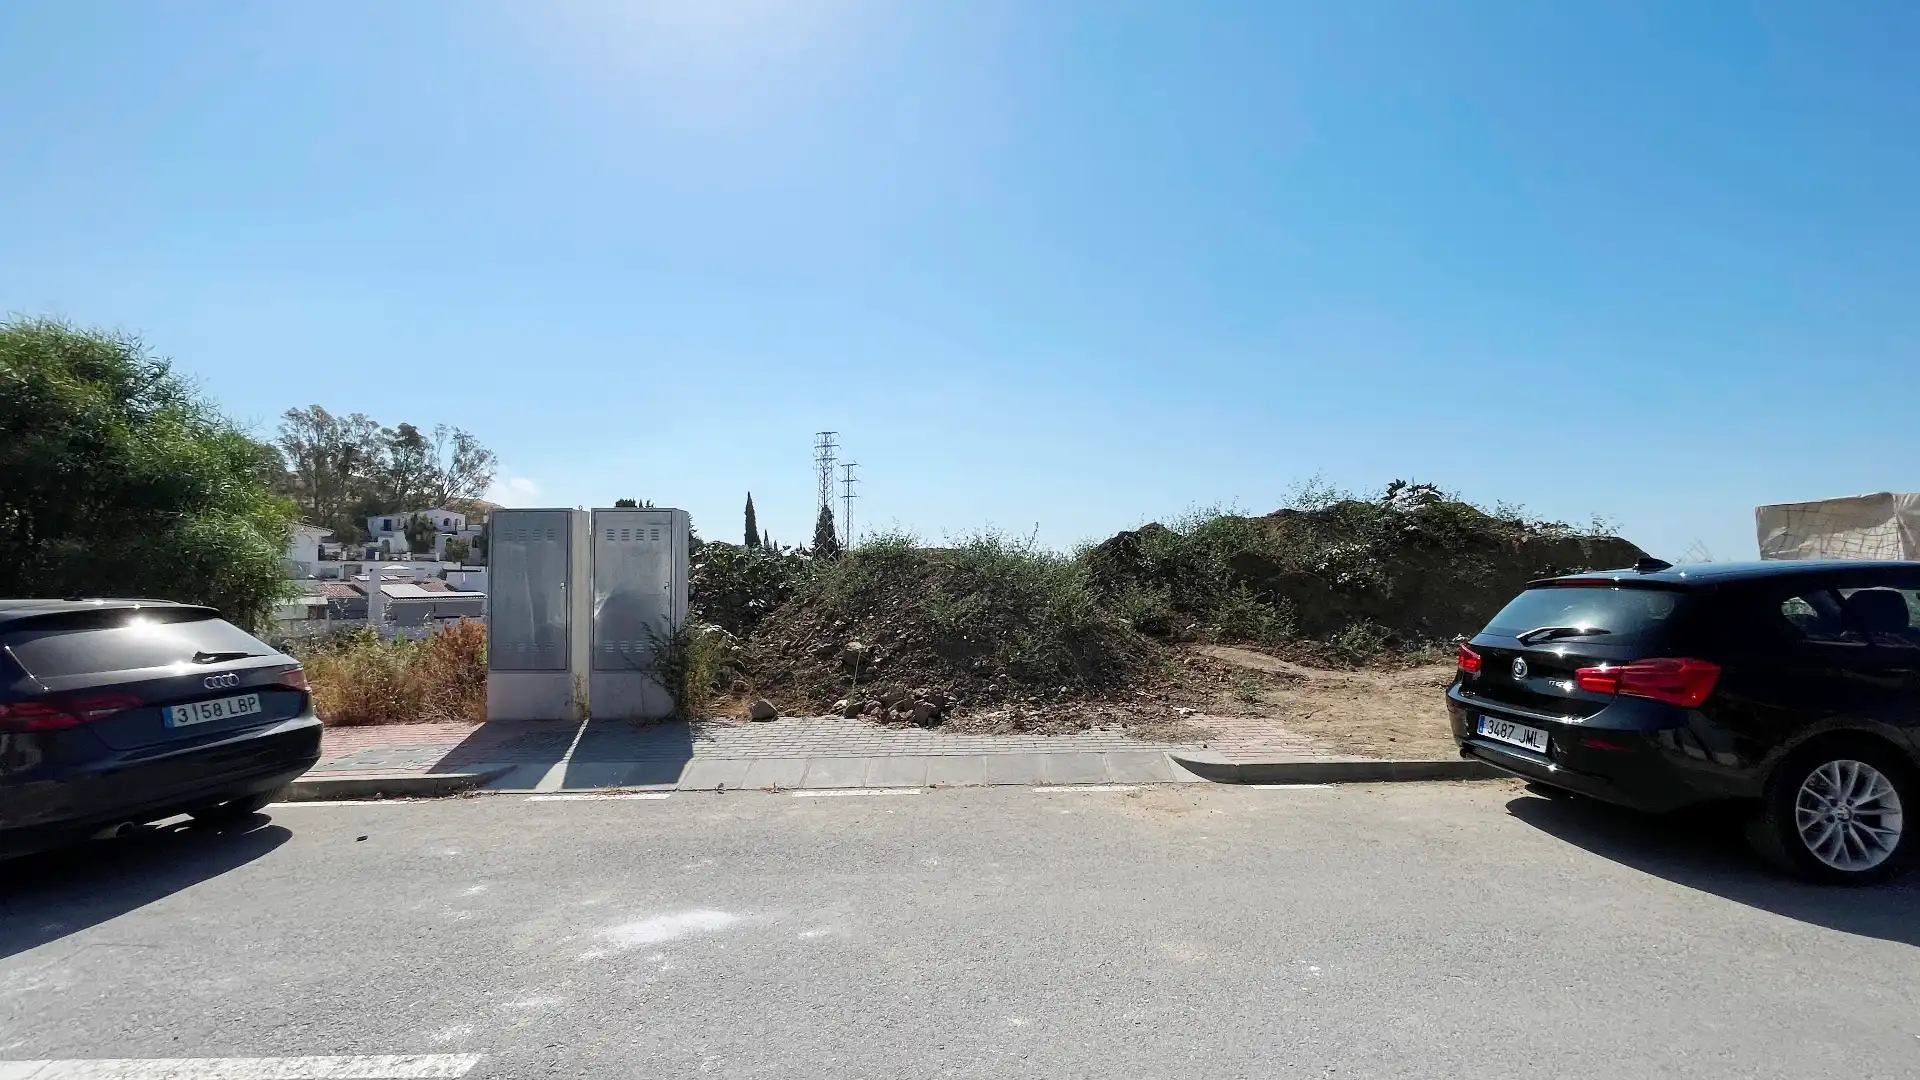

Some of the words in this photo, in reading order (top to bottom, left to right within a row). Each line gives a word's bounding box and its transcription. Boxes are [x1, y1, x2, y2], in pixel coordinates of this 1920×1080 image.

[176, 702, 223, 723] 3158
[227, 696, 256, 715] LBP
[1487, 720, 1515, 740] 3487
[1519, 728, 1541, 748] JML
